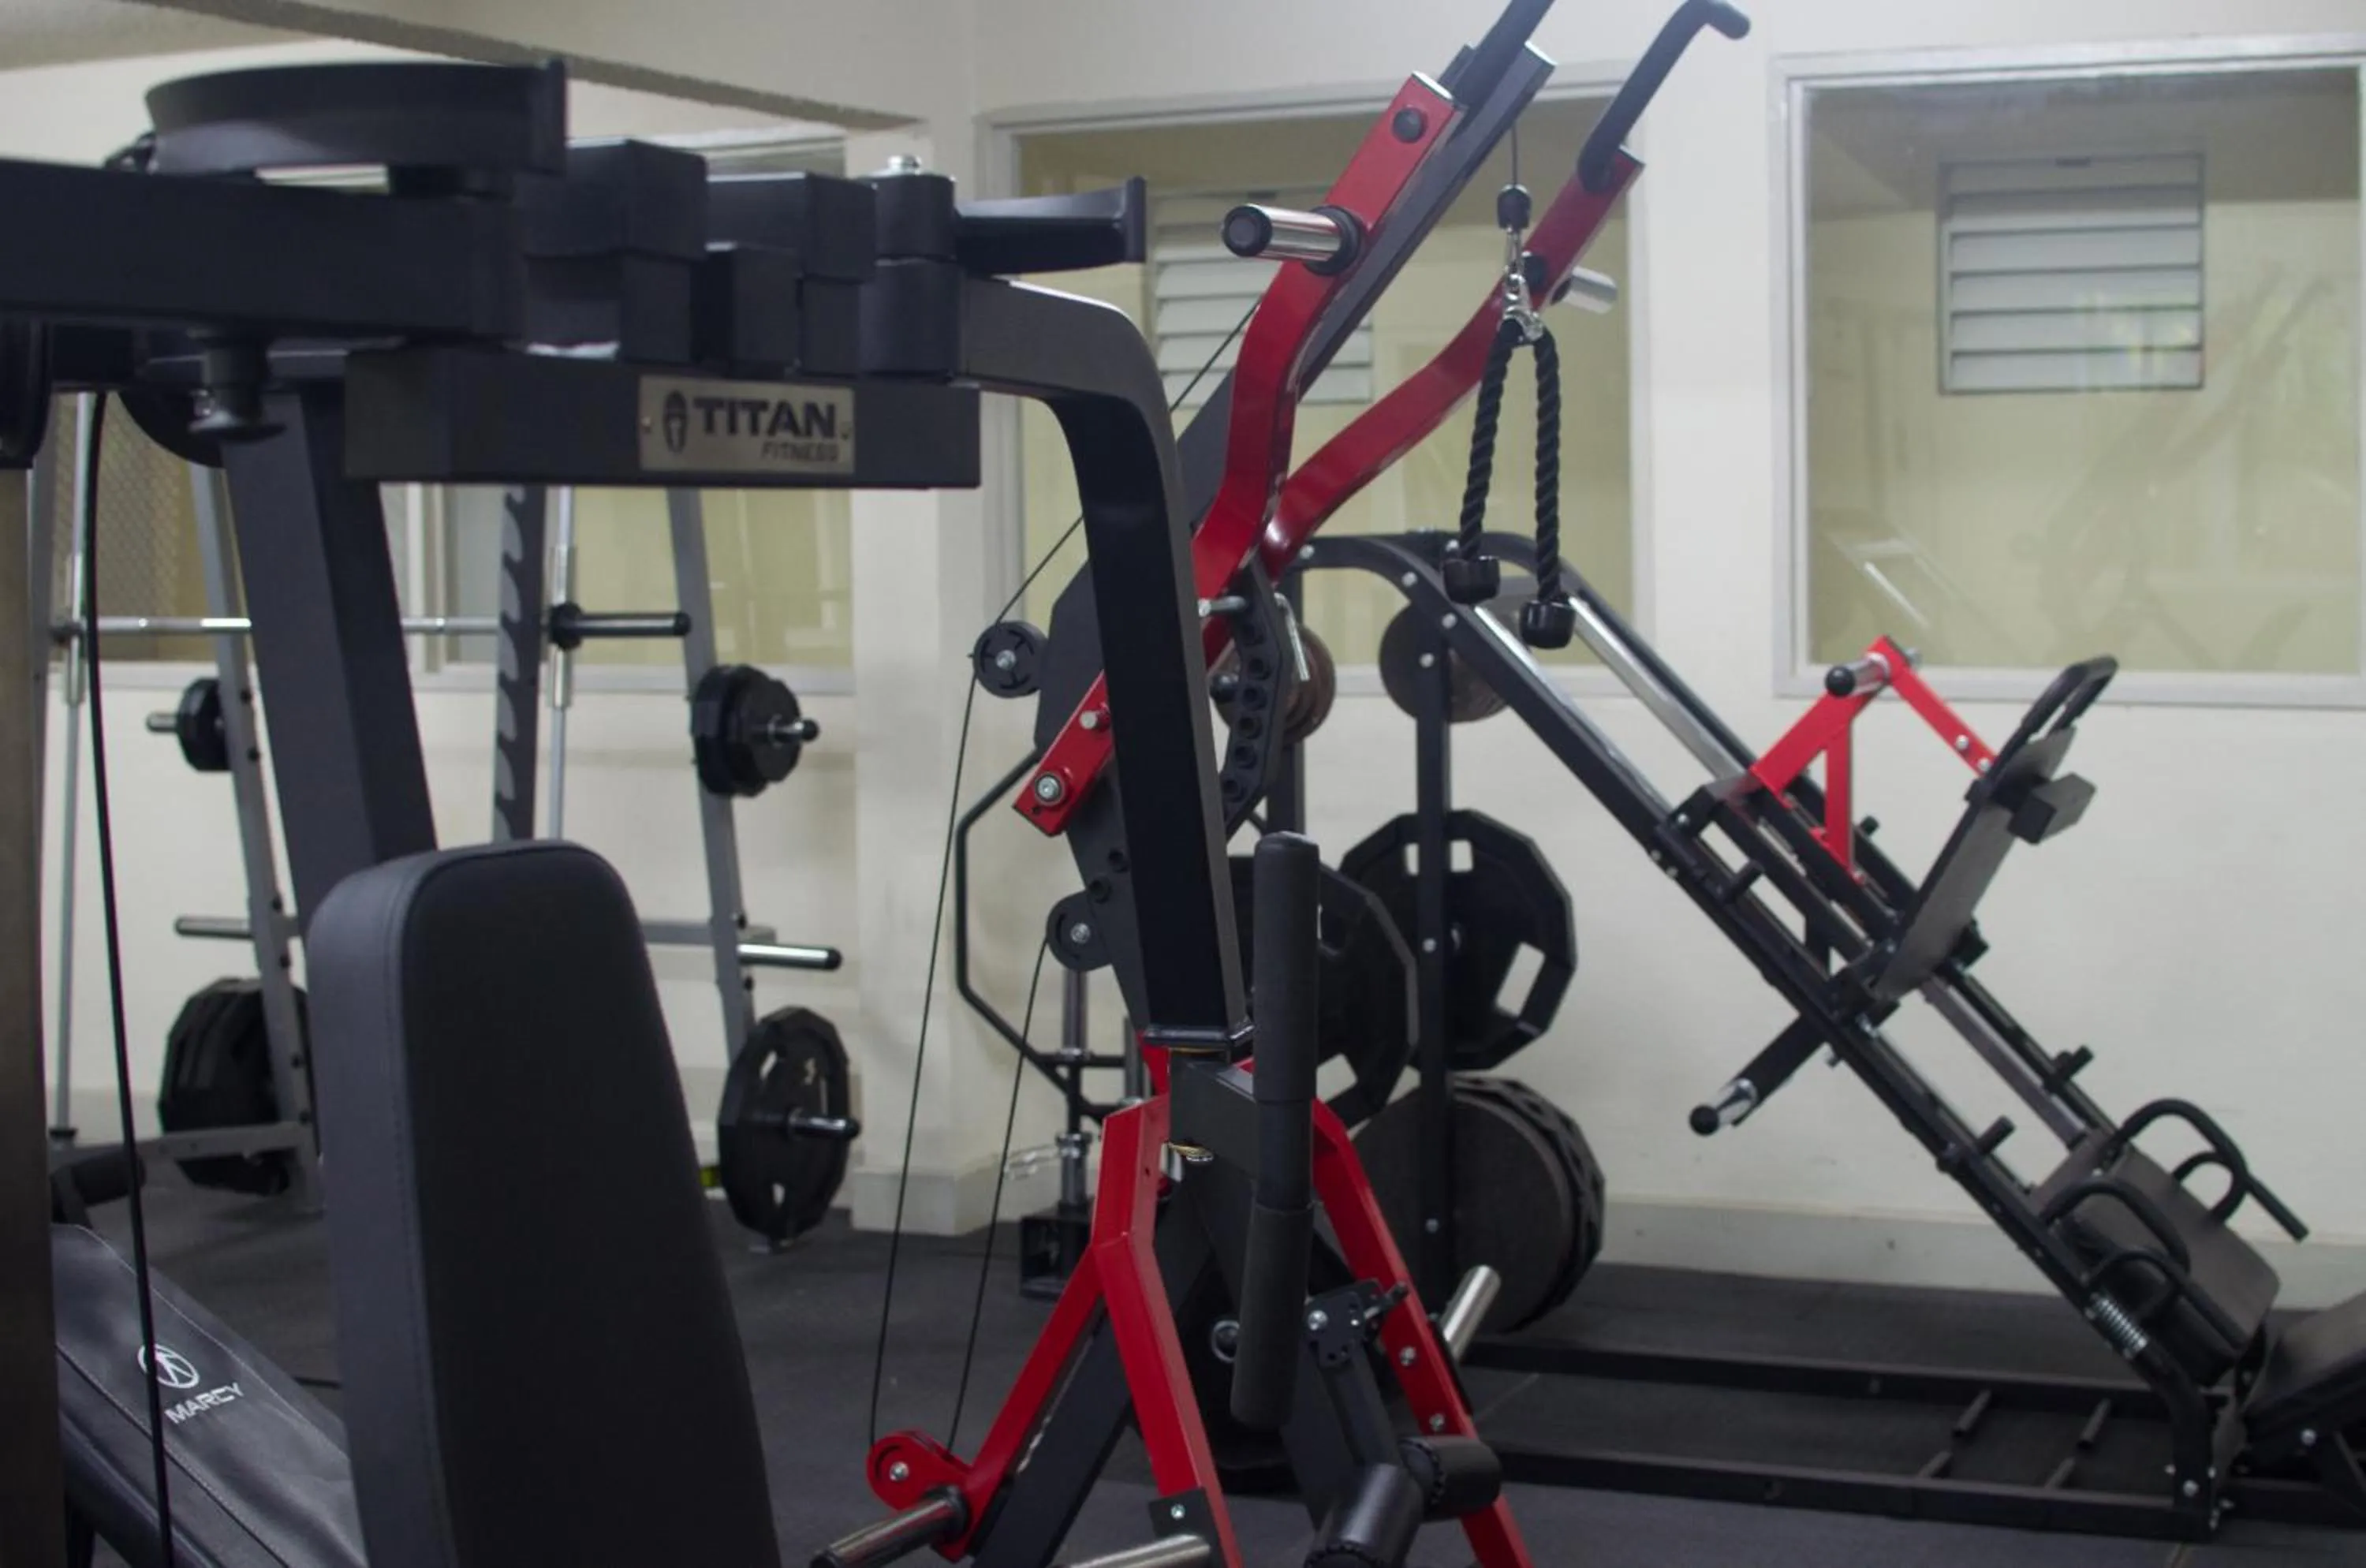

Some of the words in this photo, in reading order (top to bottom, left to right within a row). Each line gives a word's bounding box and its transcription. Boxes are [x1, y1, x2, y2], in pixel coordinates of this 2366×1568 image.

[692, 397, 836, 439] TITAN
[760, 441, 839, 462] FITNESS
[164, 1382, 244, 1424] MARCY
